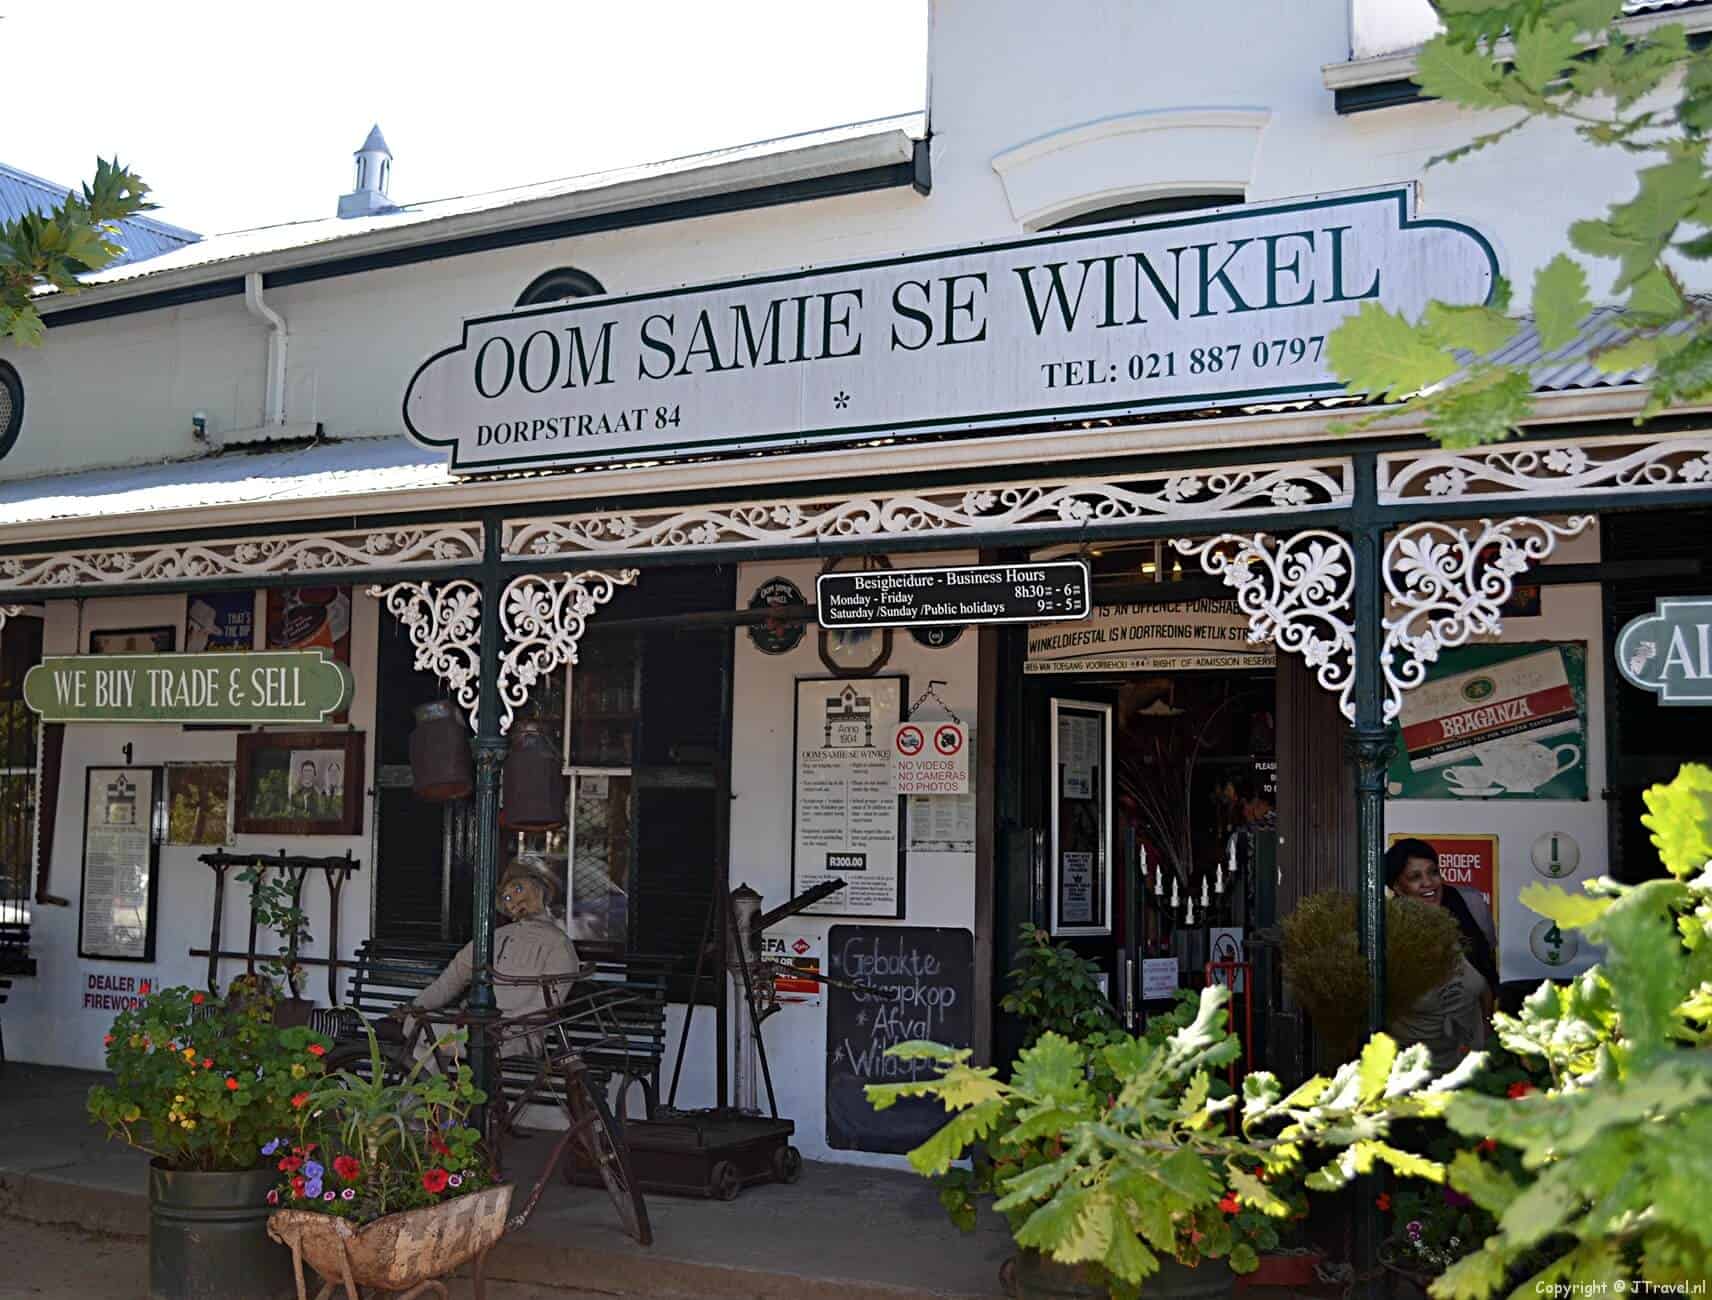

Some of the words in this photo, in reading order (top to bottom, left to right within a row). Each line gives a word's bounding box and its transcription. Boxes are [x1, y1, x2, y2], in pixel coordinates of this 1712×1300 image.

[474, 320, 619, 400] OOM
[638, 288, 863, 381] SAMIE
[891, 271, 988, 352] SE
[1011, 225, 1381, 336] WINKEL
[1040, 359, 1118, 389] TEL:
[1127, 351, 1176, 381] 021
[1189, 344, 1242, 375] 887
[1252, 335, 1325, 368] 0797
[476, 407, 649, 447] DORPSTRAAT
[654, 404, 681, 431] 84
[946, 571, 1003, 586] Business
[1005, 569, 1046, 583] Hours
[829, 594, 872, 609] Monday
[880, 591, 914, 605] Friday
[1185, 600, 1241, 615] PUNISHAB
[829, 605, 874, 621] Saturday
[876, 604, 918, 619] /Sunday
[919, 603, 958, 617] /Public
[960, 600, 1005, 616] holidays
[1029, 628, 1106, 653] WINKELDIEFSTAL
[1129, 624, 1193, 640] OORTREDING
[1194, 624, 1227, 640] WETLIK
[1152, 659, 1176, 669] RIGHT
[1180, 658, 1192, 668] OF
[1196, 656, 1240, 667] ADMISSION
[52, 669, 87, 708] WE
[95, 668, 137, 708] BUY
[146, 668, 219, 708] TRADE
[227, 667, 246, 707] &
[251, 667, 306, 707] SELL
[1439, 697, 1535, 738] BRAGANZA
[898, 761, 914, 770] NO
[916, 760, 954, 770] VIDEOS
[898, 771, 914, 781] NO
[915, 770, 967, 781] CAMERAS
[898, 782, 914, 792] NO
[915, 781, 960, 792] PHOTOS
[1438, 853, 1481, 869] GROEPE
[1439, 868, 1472, 883] KOM
[87, 974, 136, 993] DEALER
[83, 992, 153, 1012] FIREWORK
